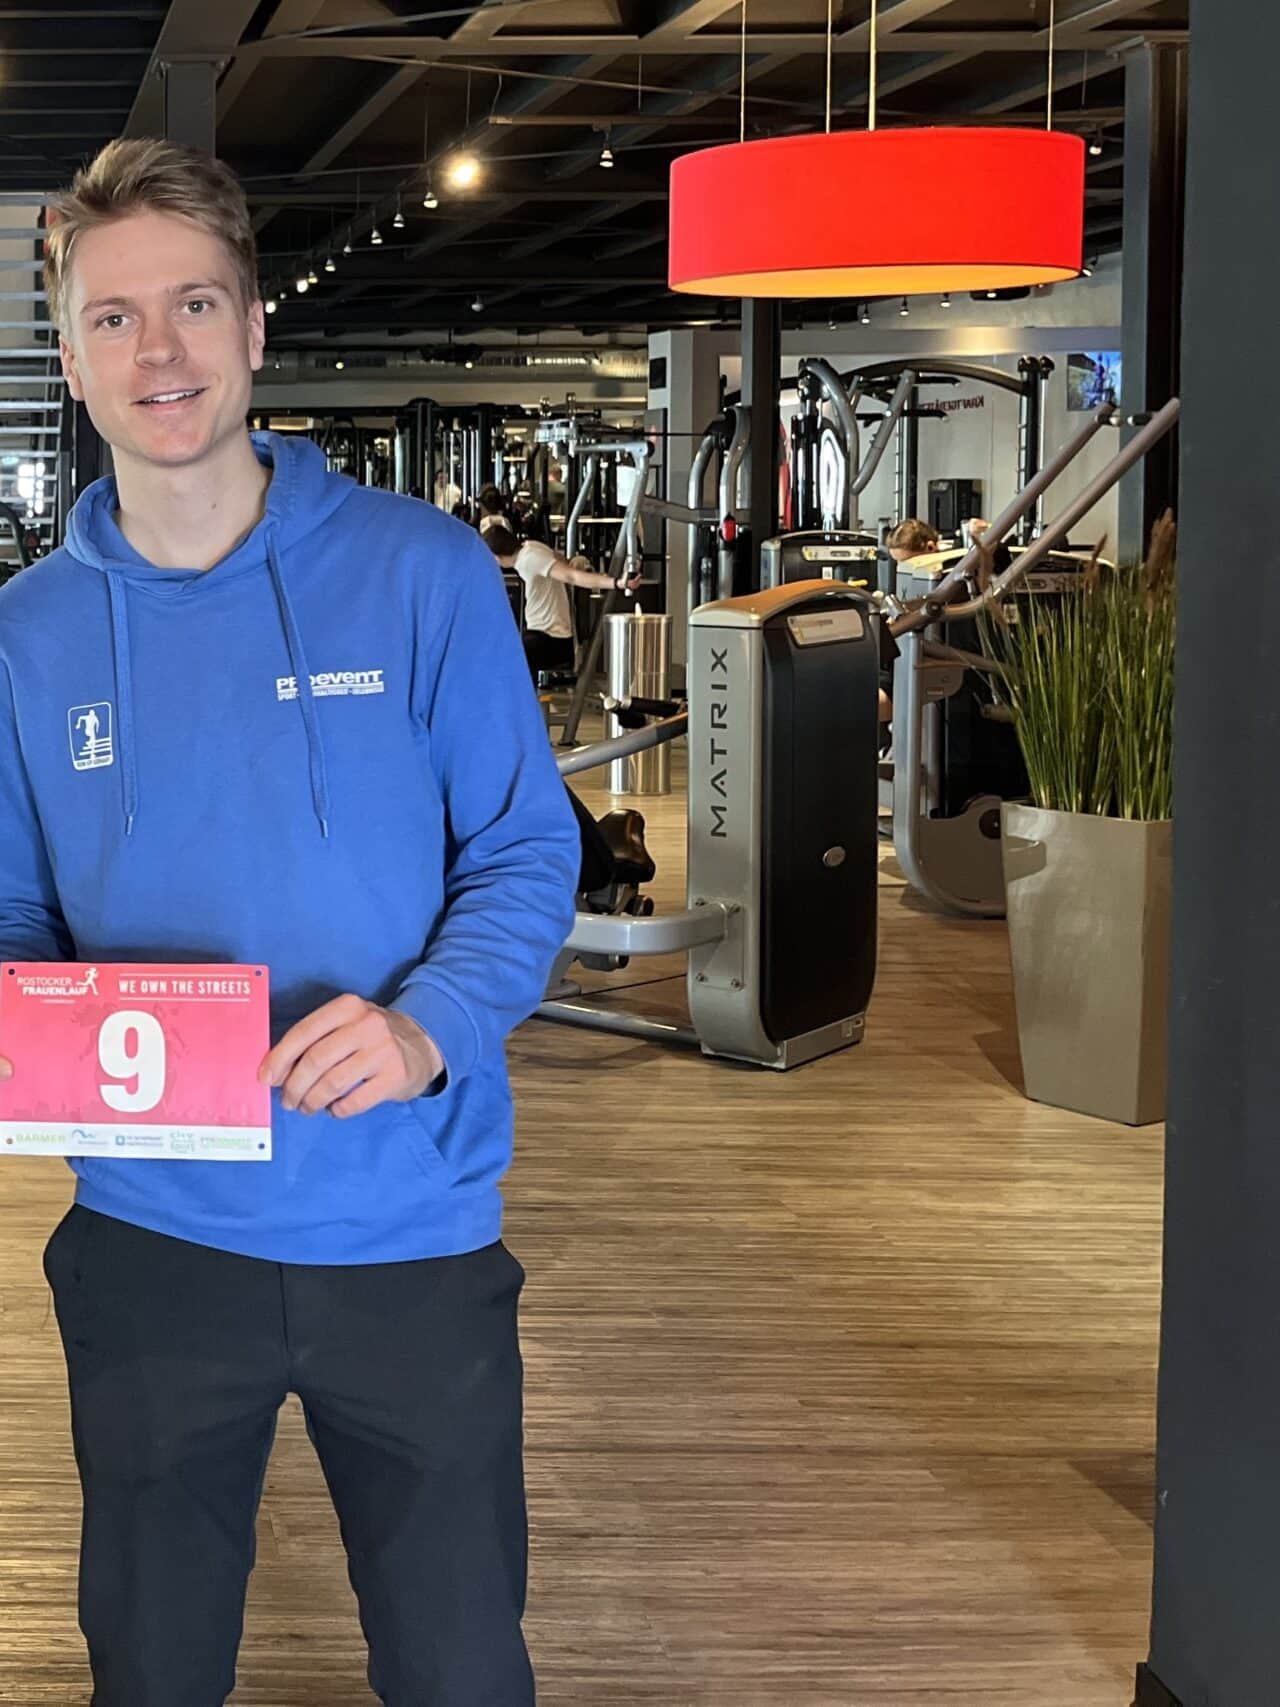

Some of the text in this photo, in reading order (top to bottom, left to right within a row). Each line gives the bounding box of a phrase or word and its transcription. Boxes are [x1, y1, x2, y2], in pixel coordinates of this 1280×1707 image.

[710, 648, 728, 838] MATRIX
[17, 976, 72, 986] ROSTOCKER
[119, 980, 251, 994] WE OWN THE STREETS
[22, 986, 89, 996] FRAUENLAUF
[98, 1010, 166, 1113] 9
